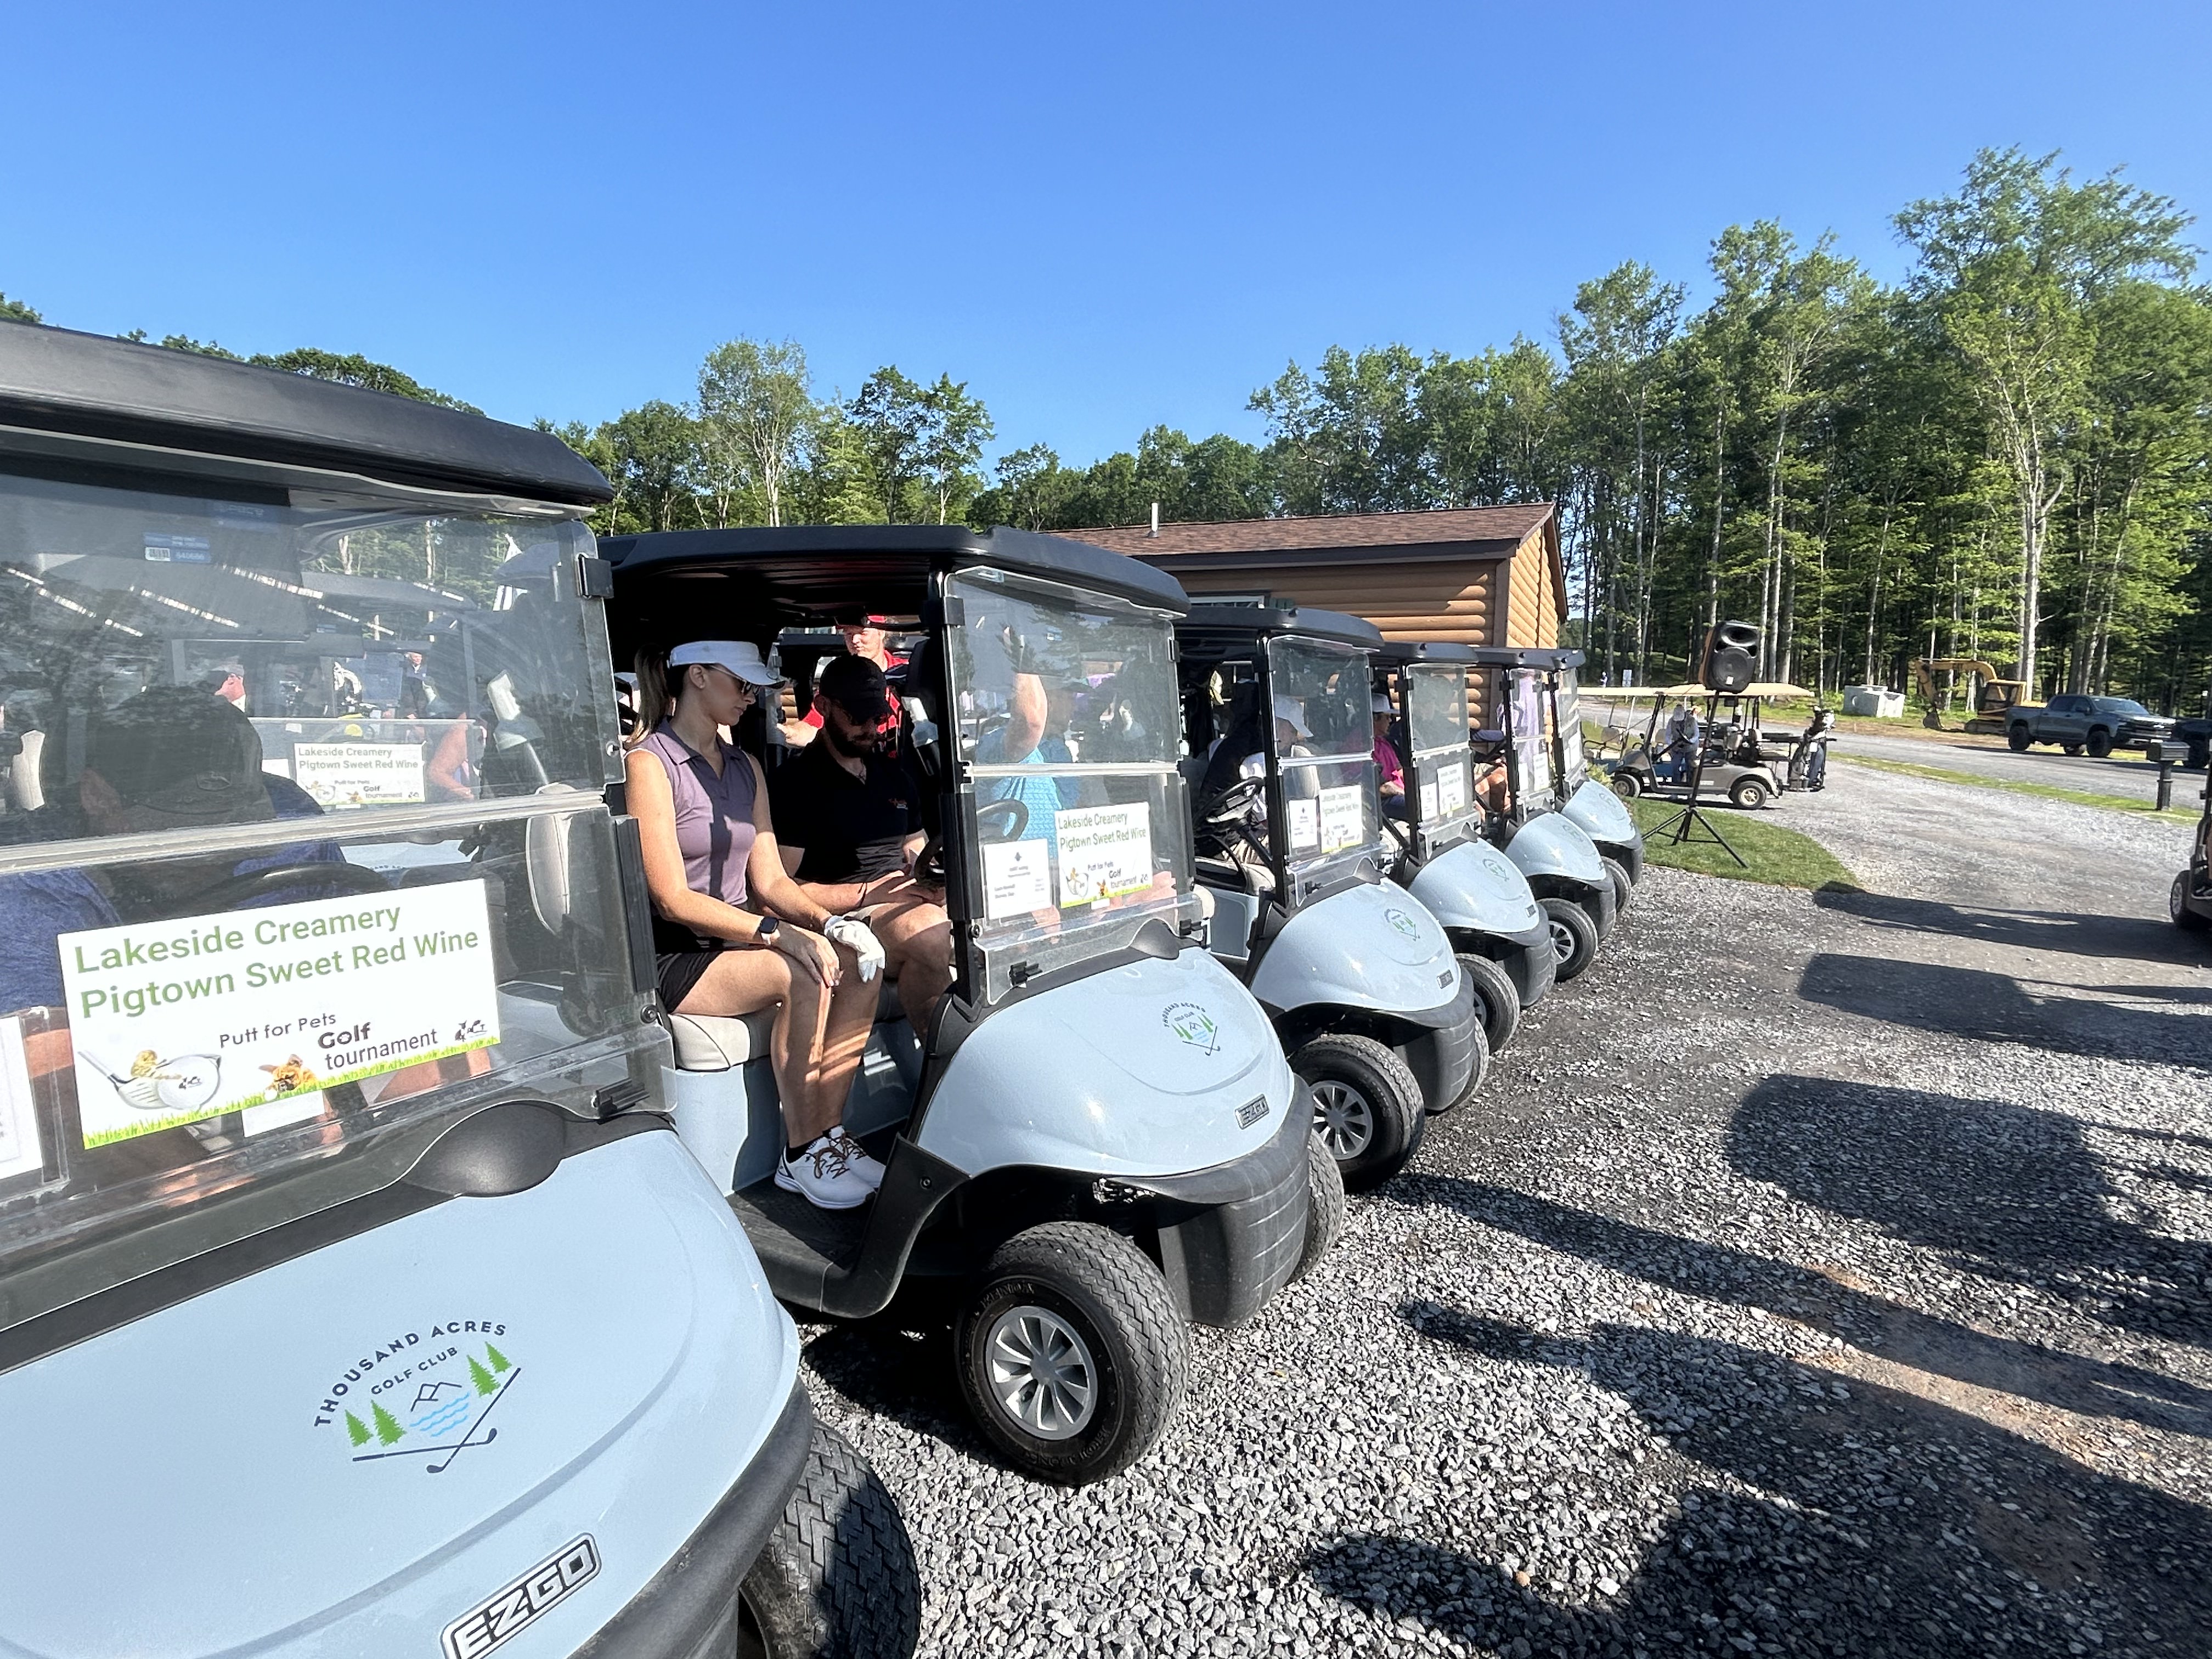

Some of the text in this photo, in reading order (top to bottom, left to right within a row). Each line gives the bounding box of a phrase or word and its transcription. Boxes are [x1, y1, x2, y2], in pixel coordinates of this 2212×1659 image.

[298, 747, 392, 758] Lakeside Creamery
[299, 760, 419, 771] Pigtown Sweet Red Wine
[1058, 813, 1128, 830] Lakeside Creamery
[1060, 836, 1092, 852] Pigtown
[1093, 832, 1115, 845] Sweet
[1116, 828, 1130, 842] Red
[1109, 868, 1121, 878] Golf
[75, 907, 400, 974] Lakeside Creamery
[81, 931, 478, 1018] Pigtown Sweet Red Wine
[219, 1013, 336, 1048] Putt for Pets
[318, 1022, 371, 1049] Golf
[325, 1029, 438, 1070] tournament
[313, 1321, 506, 1426] THOUSAND ACRES
[371, 1346, 458, 1395] GOLF CLUB
